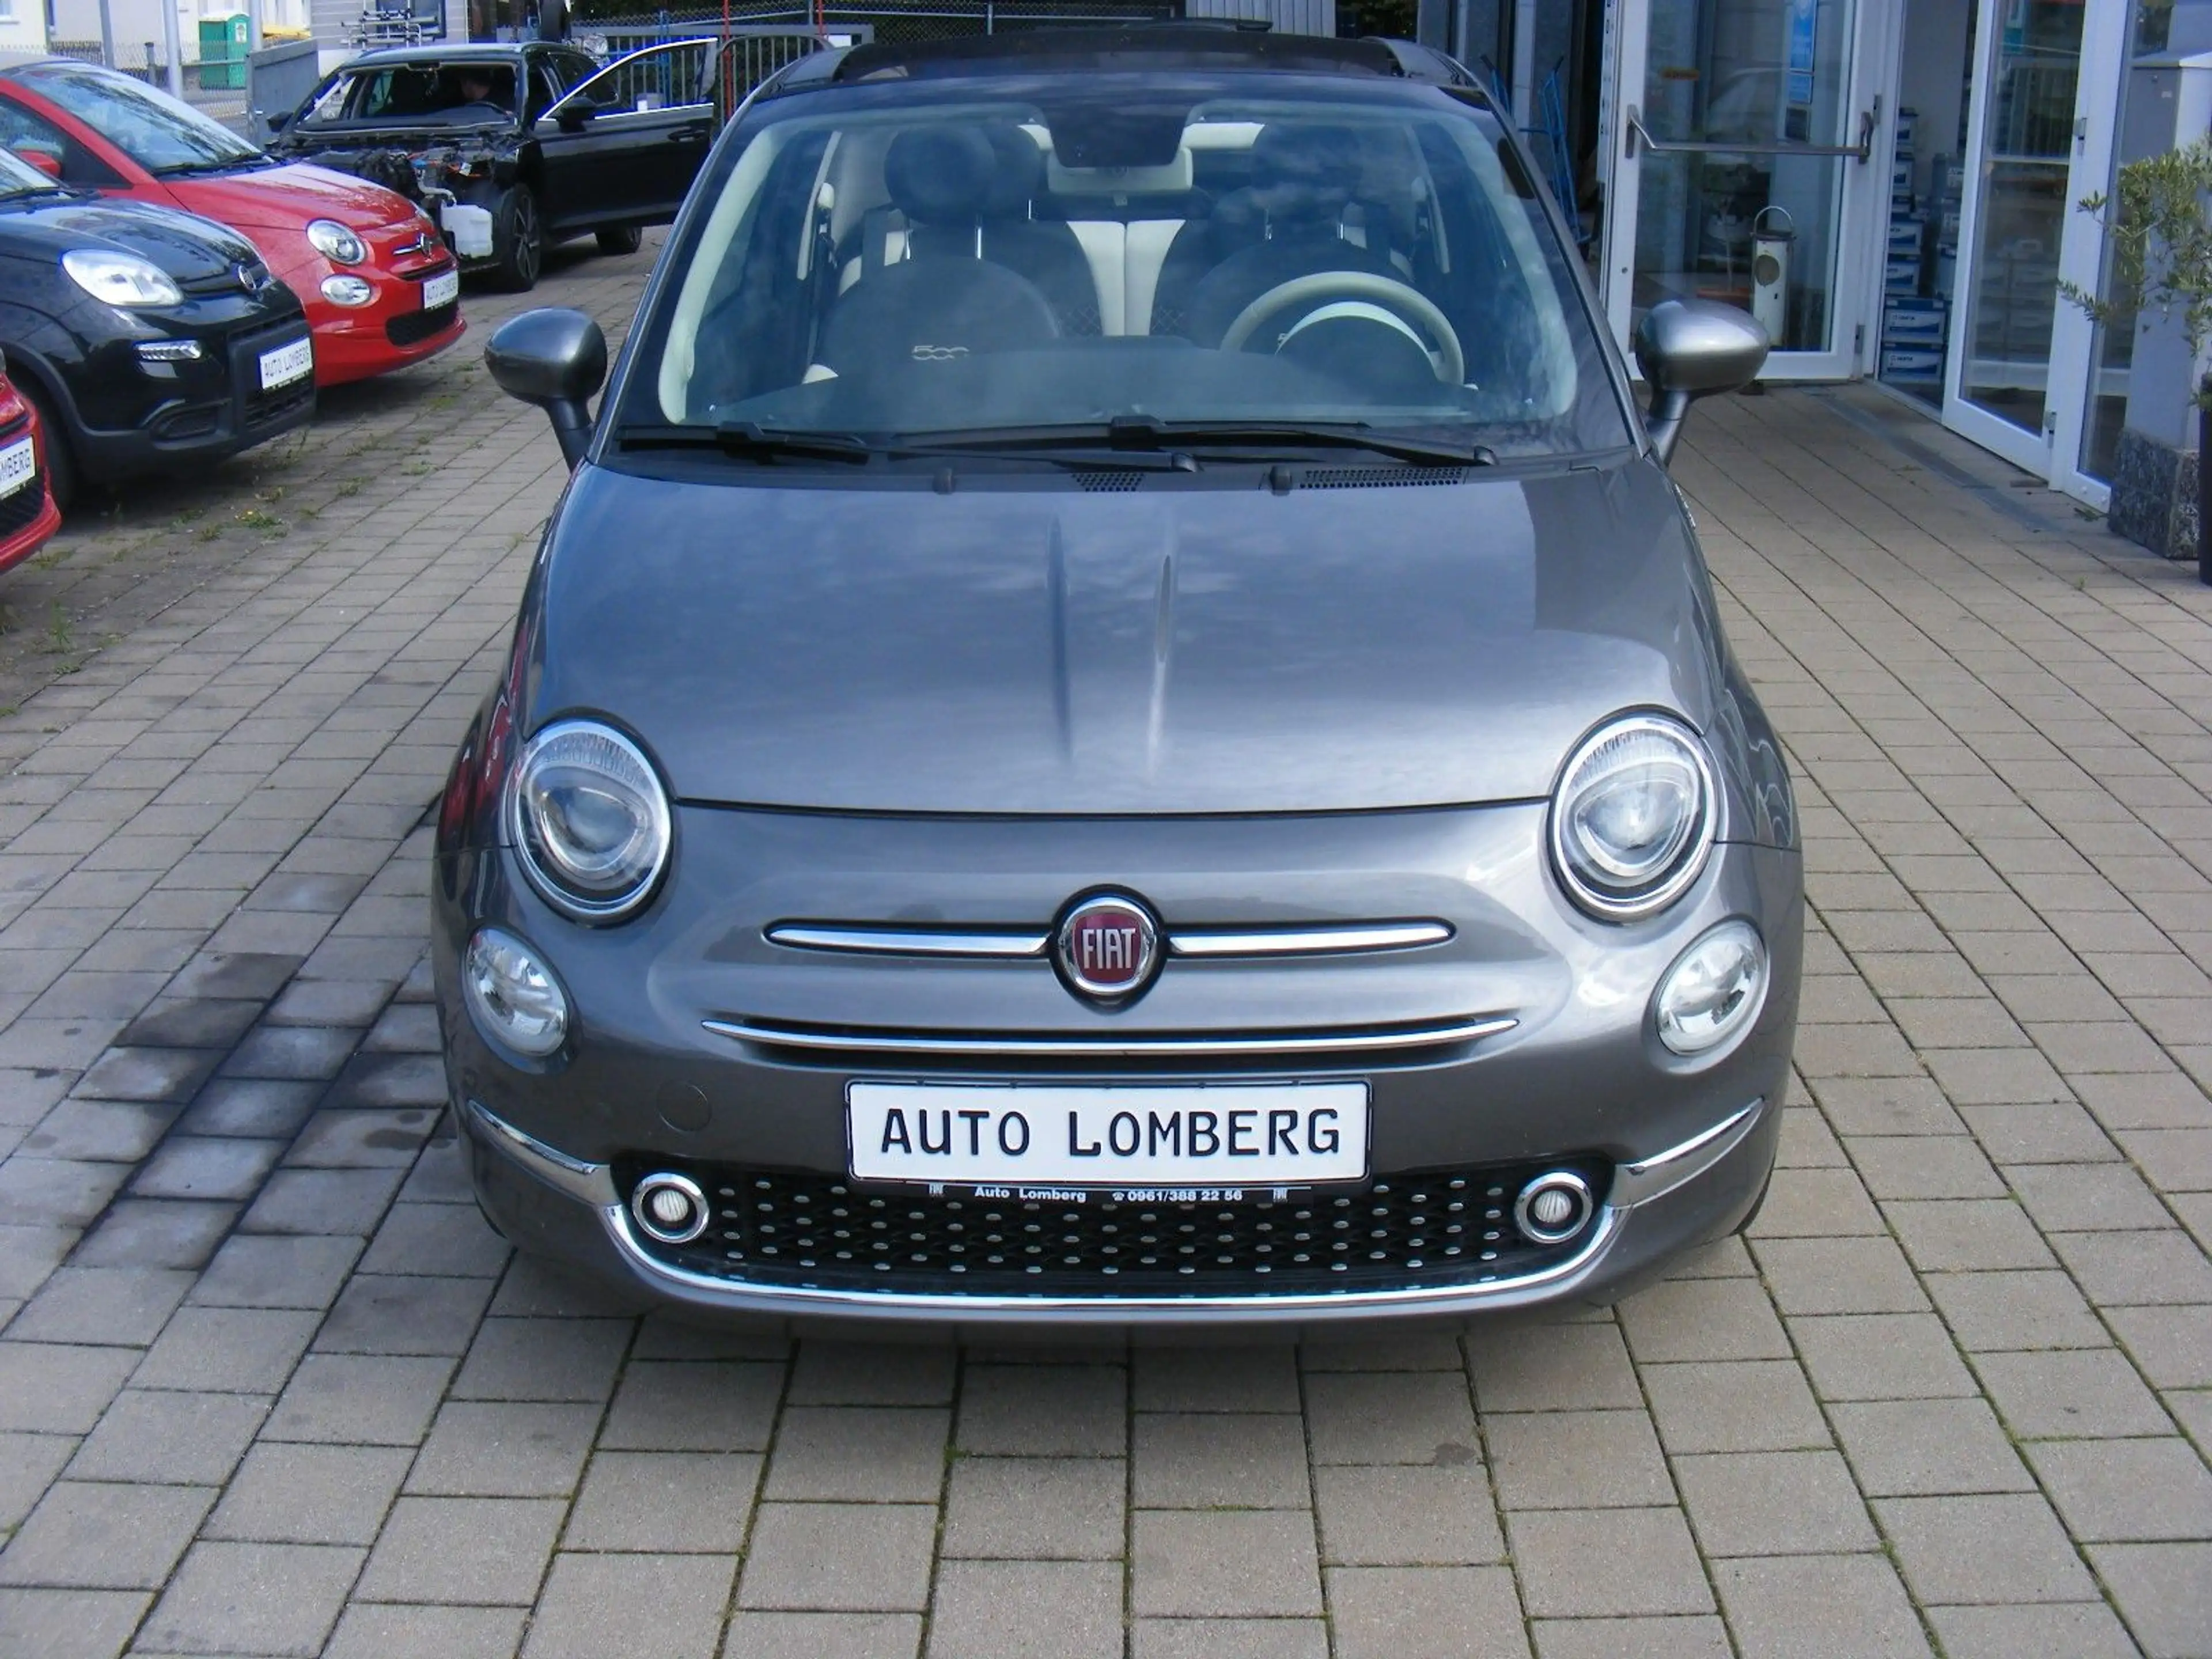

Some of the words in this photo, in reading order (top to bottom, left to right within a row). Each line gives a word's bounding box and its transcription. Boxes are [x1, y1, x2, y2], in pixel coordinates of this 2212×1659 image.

[265, 358, 281, 377] AUTO
[283, 345, 310, 372] LOMBERG
[911, 345, 969, 361] 500
[1082, 929, 1136, 969] FIAT
[882, 1109, 1029, 1156] AUTO
[1070, 1108, 1339, 1156] LOMBERG
[975, 1186, 1010, 1198] Auto
[1018, 1188, 1086, 1203] Lomberg
[1201, 1190, 1219, 1201] 22
